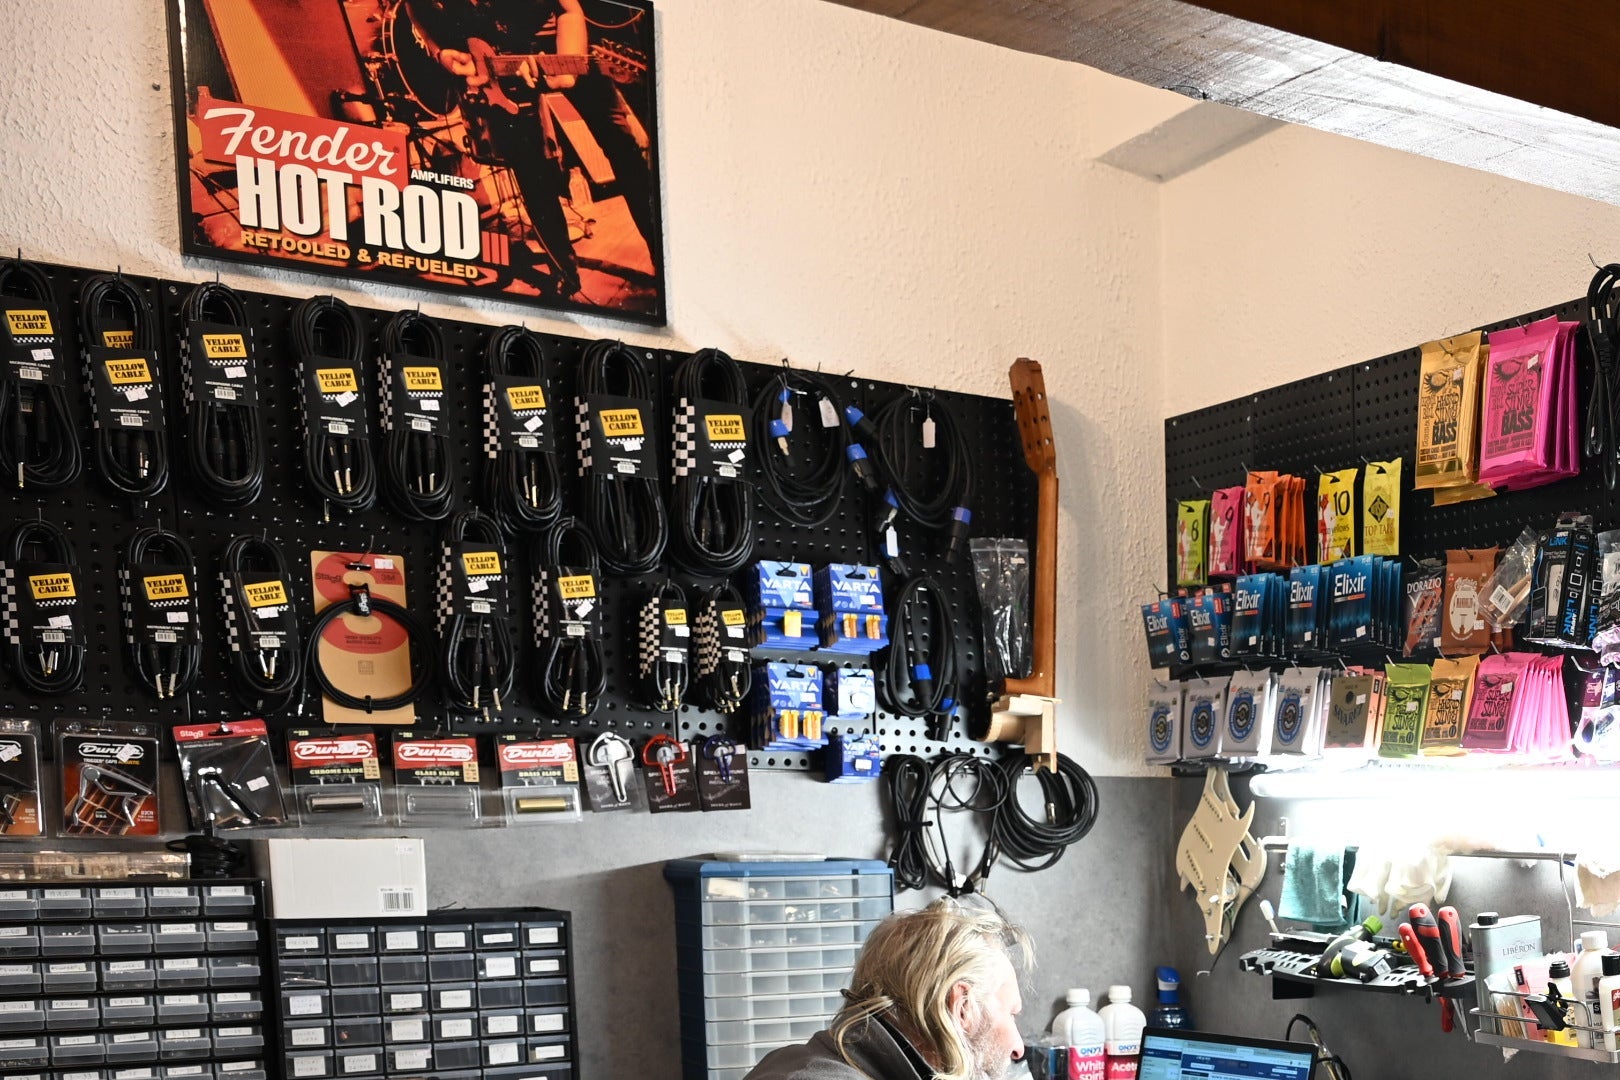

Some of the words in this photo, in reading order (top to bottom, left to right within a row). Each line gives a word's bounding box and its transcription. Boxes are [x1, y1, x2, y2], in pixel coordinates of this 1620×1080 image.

[204, 107, 398, 177] Fender
[410, 168, 475, 190] AMPLIFIERS
[236, 155, 352, 241] HOT
[363, 181, 481, 262] ROD
[241, 230, 351, 261] RETOOLED
[357, 249, 372, 263] &
[378, 252, 479, 280] REFUELED
[8, 314, 48, 325] YELLOW
[15, 321, 48, 331] CABLE
[106, 334, 133, 345] YELLO
[205, 337, 242, 348] YELLOW
[211, 345, 243, 355] CABLE
[107, 362, 146, 374] YELLOW
[115, 370, 146, 380] CABLE
[319, 372, 353, 382] YELLOW
[405, 370, 439, 380] YELLOW
[325, 379, 353, 389] CABLE
[410, 377, 439, 387] CABLE
[1507, 379, 1537, 396] SUPER
[509, 388, 542, 399] YELLOW
[514, 396, 541, 406] CABLE
[602, 412, 640, 423] YELLOW
[708, 418, 741, 428] YELLOW
[1501, 409, 1534, 436] BASS
[608, 420, 639, 431] CABLE
[712, 426, 741, 436] CABLE
[1432, 420, 1458, 445] BASS
[1333, 490, 1351, 517] 10
[1225, 506, 1234, 527] 9
[1191, 518, 1199, 542] 8
[1365, 525, 1379, 537] TOP
[1549, 537, 1568, 547] LiNK
[465, 554, 497, 564] YELLOW
[469, 561, 497, 571] CABLE
[31, 576, 71, 588] YELLOW
[146, 578, 182, 589] YELLOW
[561, 578, 591, 588] YELLOW
[761, 577, 812, 592] VARTA
[832, 580, 881, 594] VARTA
[1335, 572, 1366, 597] Elixir
[1406, 576, 1442, 595] D'ORAZIO
[38, 584, 71, 595] CABLE
[152, 585, 183, 595] CABLE
[247, 584, 282, 595] YELLOW
[565, 585, 592, 594] CABLE
[1291, 581, 1314, 603] Elixir
[252, 592, 282, 602] CABLE
[1236, 590, 1261, 611] Elixir
[1190, 608, 1211, 627] Elixir
[1562, 599, 1574, 634] LiNK
[1147, 615, 1168, 632] Elixir
[770, 679, 819, 692] VARTA
[181, 729, 204, 739] Stagg
[1502, 942, 1536, 956] LIBÉRON
[1080, 1046, 1102, 1055] ONYX
[1118, 1044, 1137, 1052] ONYX
